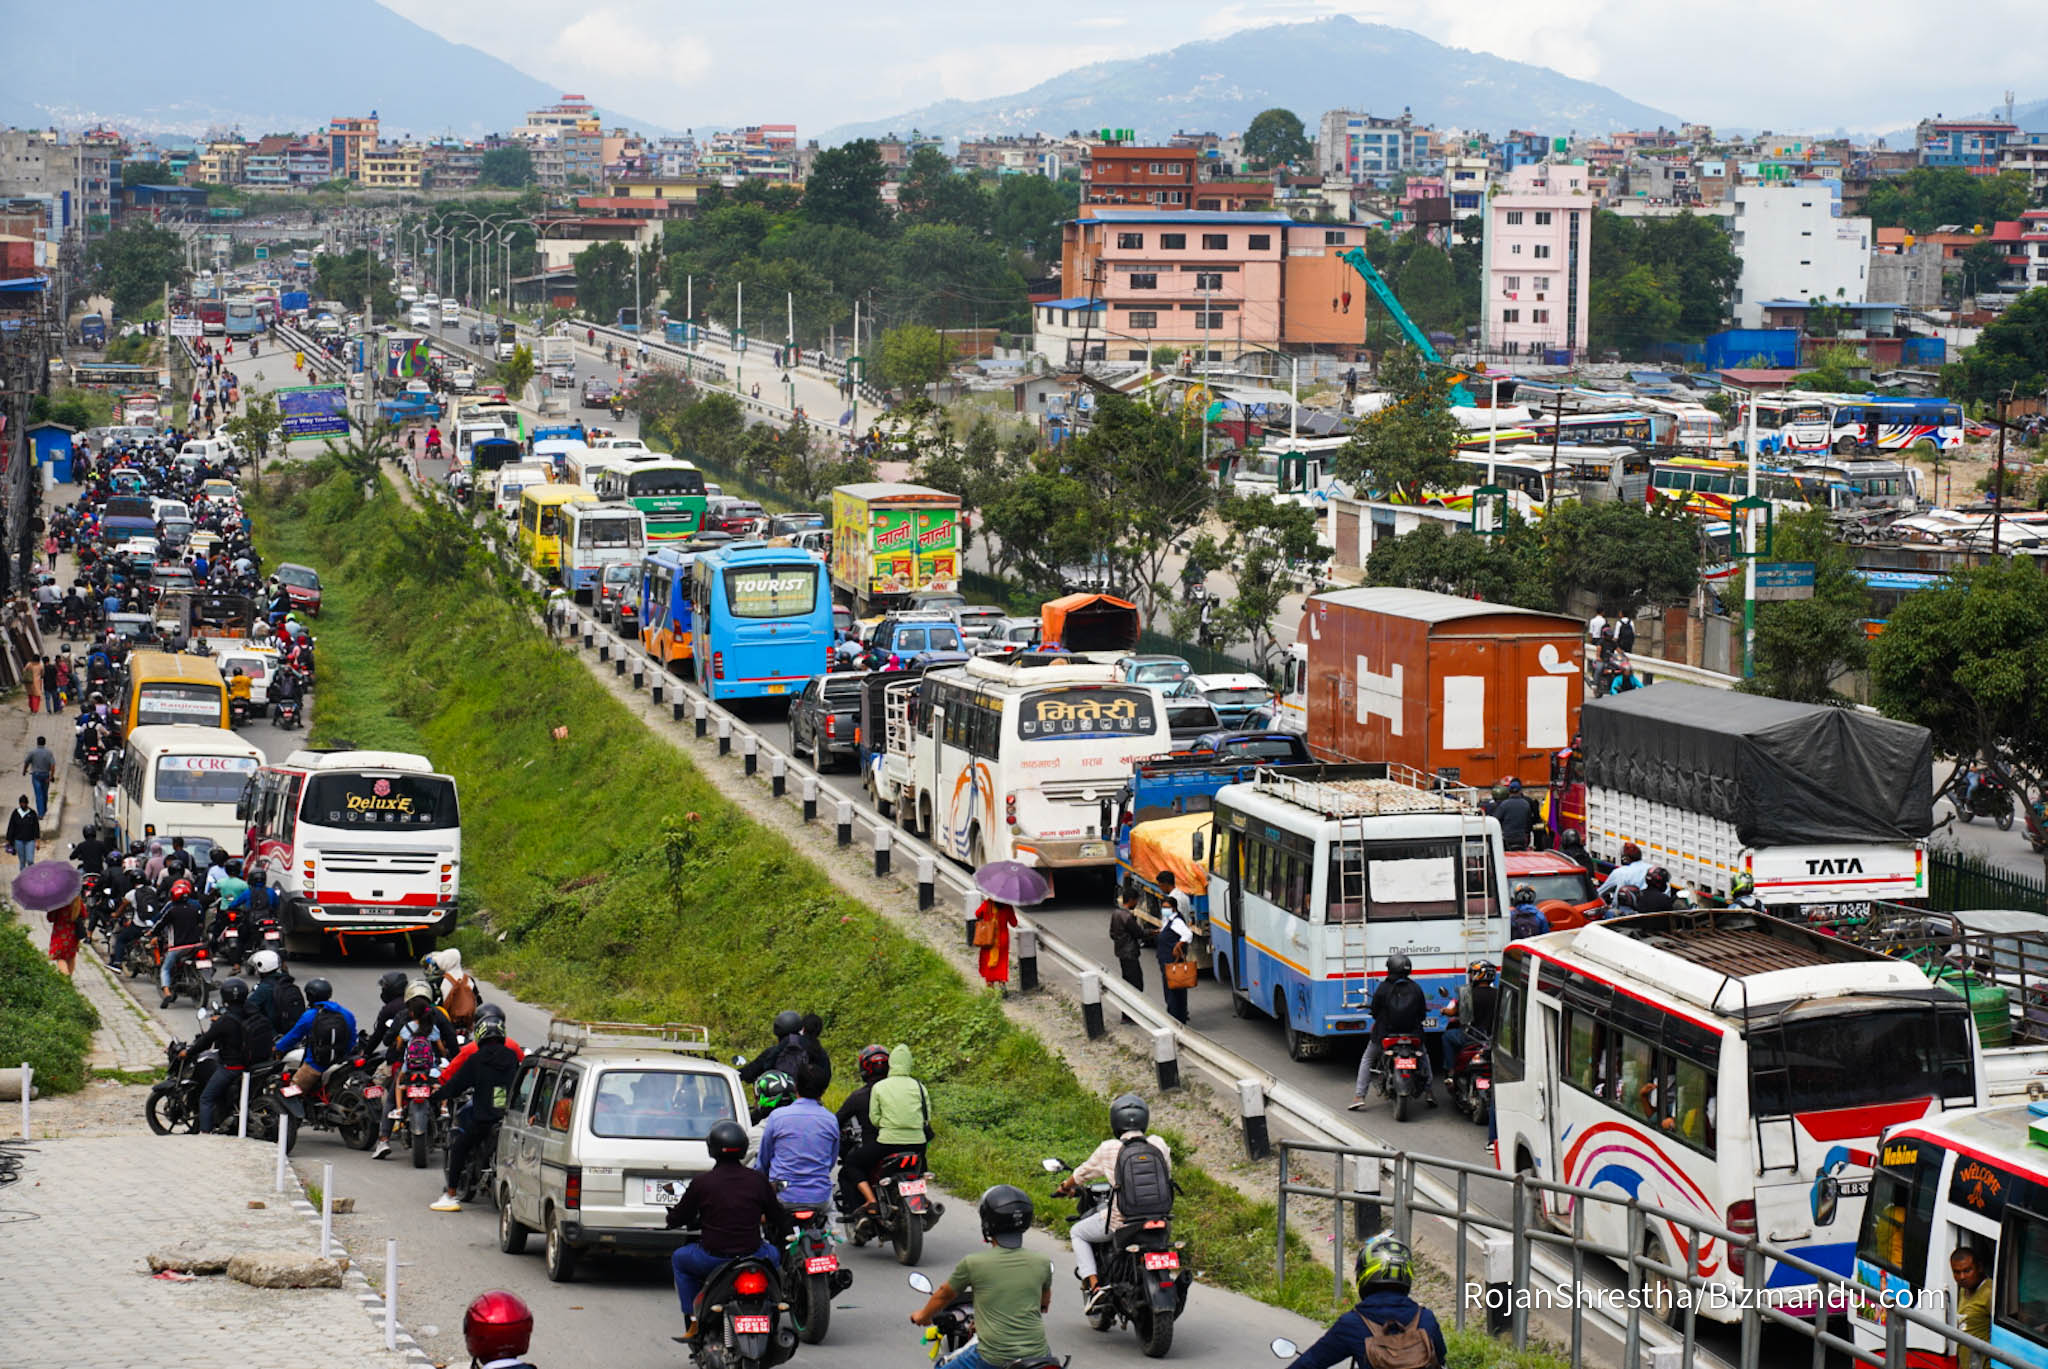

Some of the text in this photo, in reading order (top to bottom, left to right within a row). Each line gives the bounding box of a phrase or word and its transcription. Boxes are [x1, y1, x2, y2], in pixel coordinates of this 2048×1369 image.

[735, 579, 806, 592] TOURIST
[1036, 698, 1138, 721] मितेरी
[186, 758, 231, 770] CCRC
[1806, 858, 1864, 875] TATA
[1883, 1145, 1918, 1166] Nabina
[1960, 1162, 2001, 1196] WELCOME
